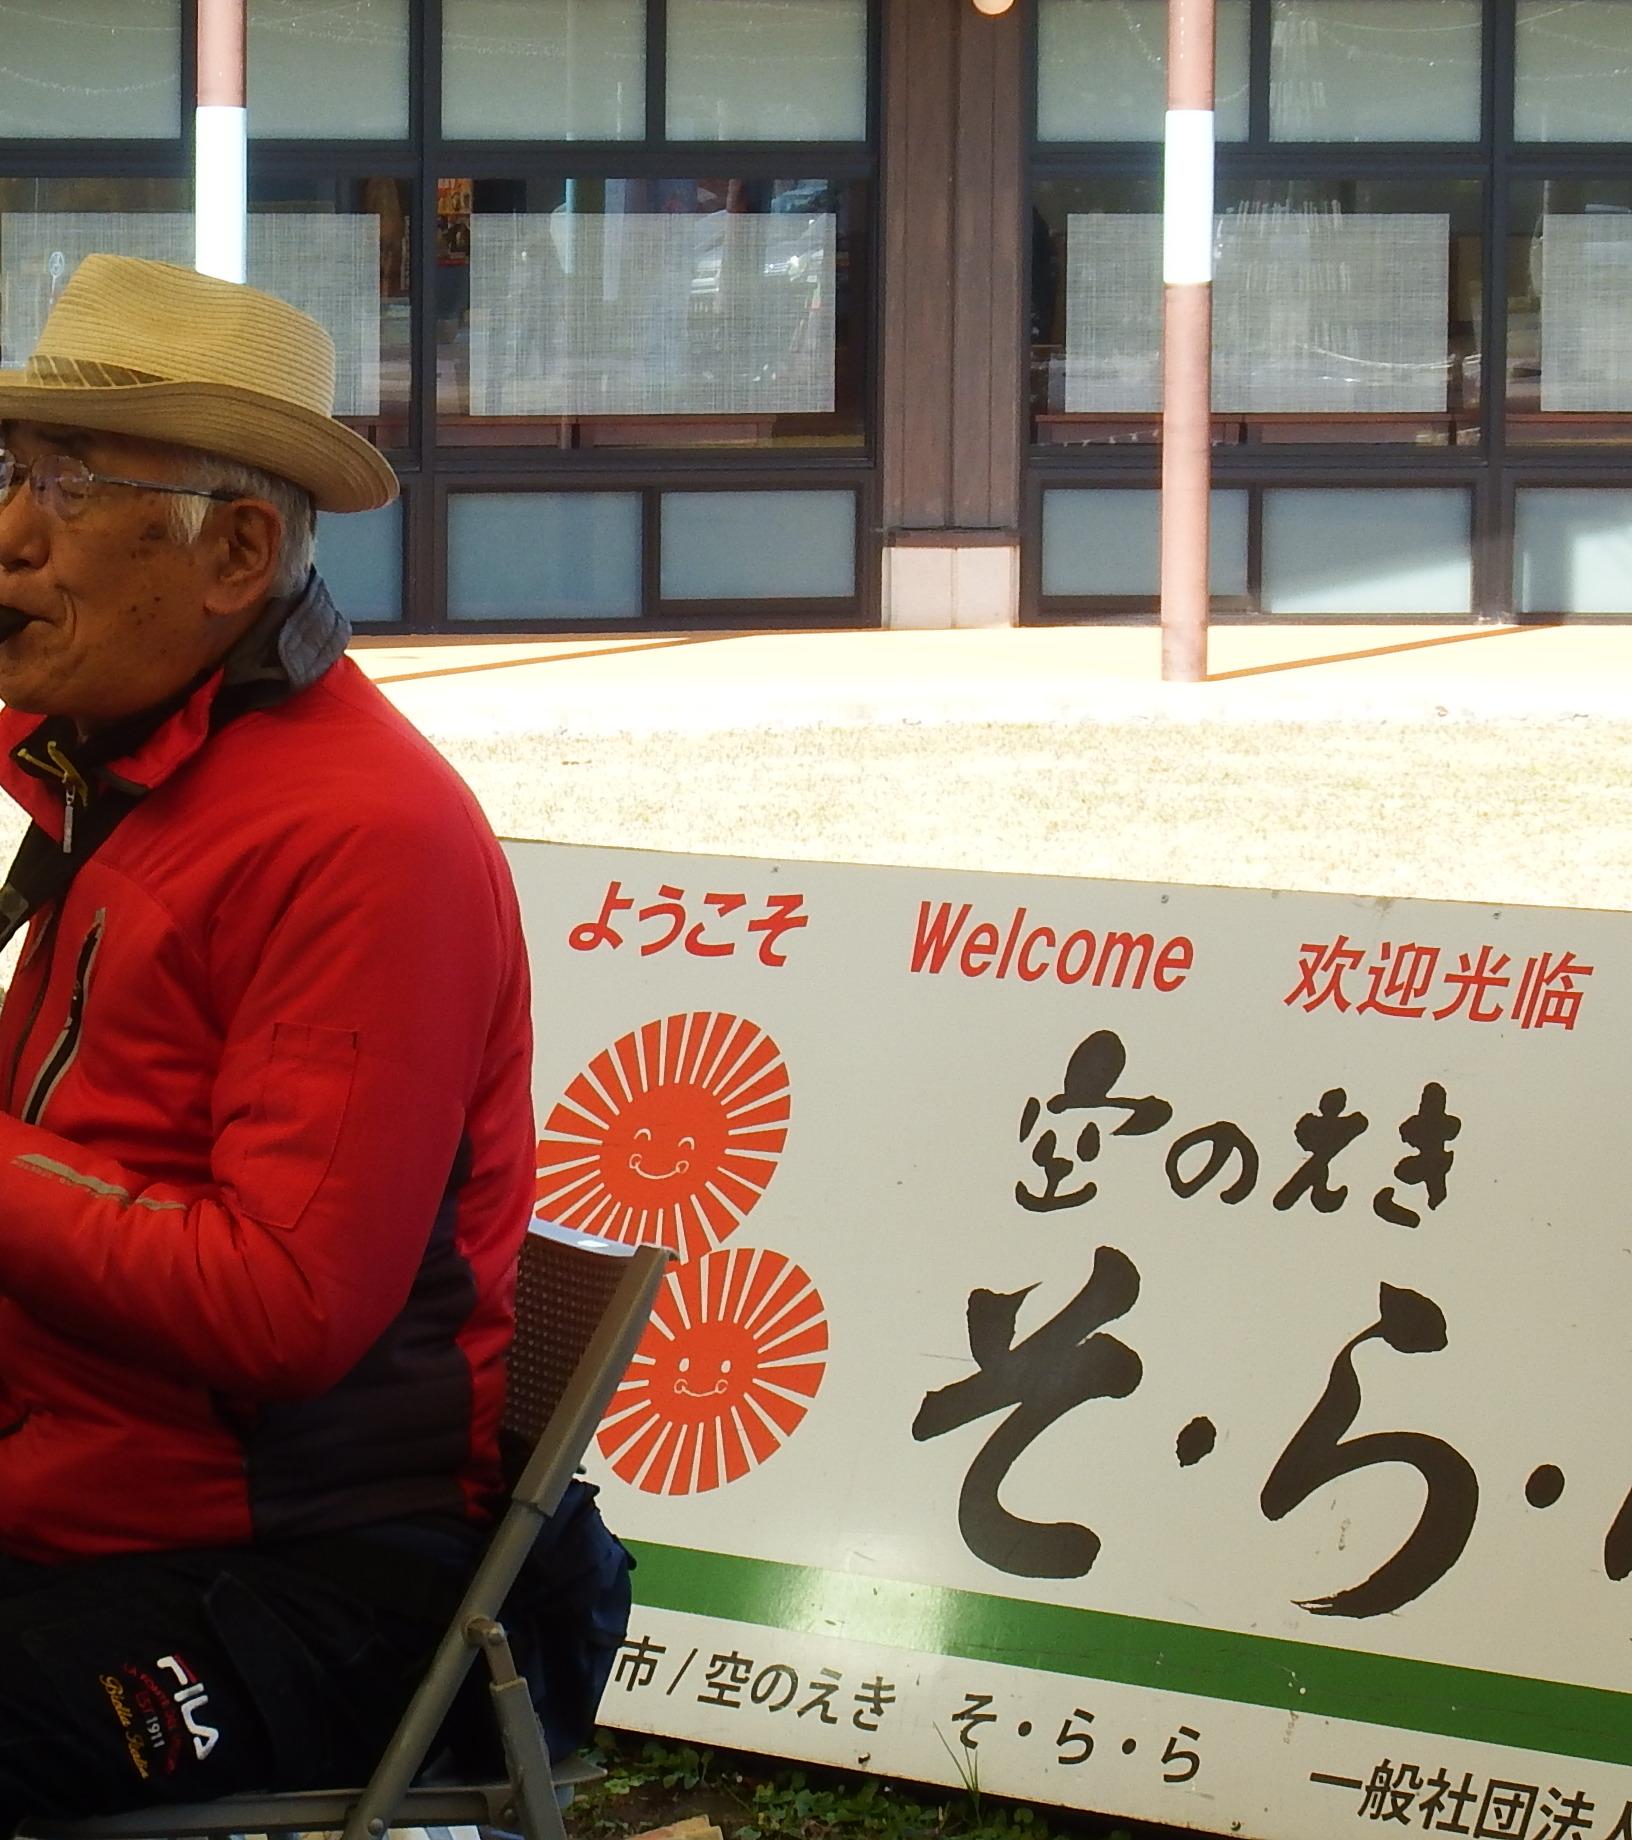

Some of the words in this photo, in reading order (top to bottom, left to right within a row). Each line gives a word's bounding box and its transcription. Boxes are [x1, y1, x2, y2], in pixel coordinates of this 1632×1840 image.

[569, 882, 807, 967] ようこそ
[911, 902, 1193, 992] Welcome
[1284, 936, 1593, 1030] 欢迎光临
[1015, 1030, 1461, 1228] 空のえき
[912, 1246, 1632, 1616] そ・ら・
[145, 1715, 165, 1749] 1911
[156, 1655, 219, 1760] FILA
